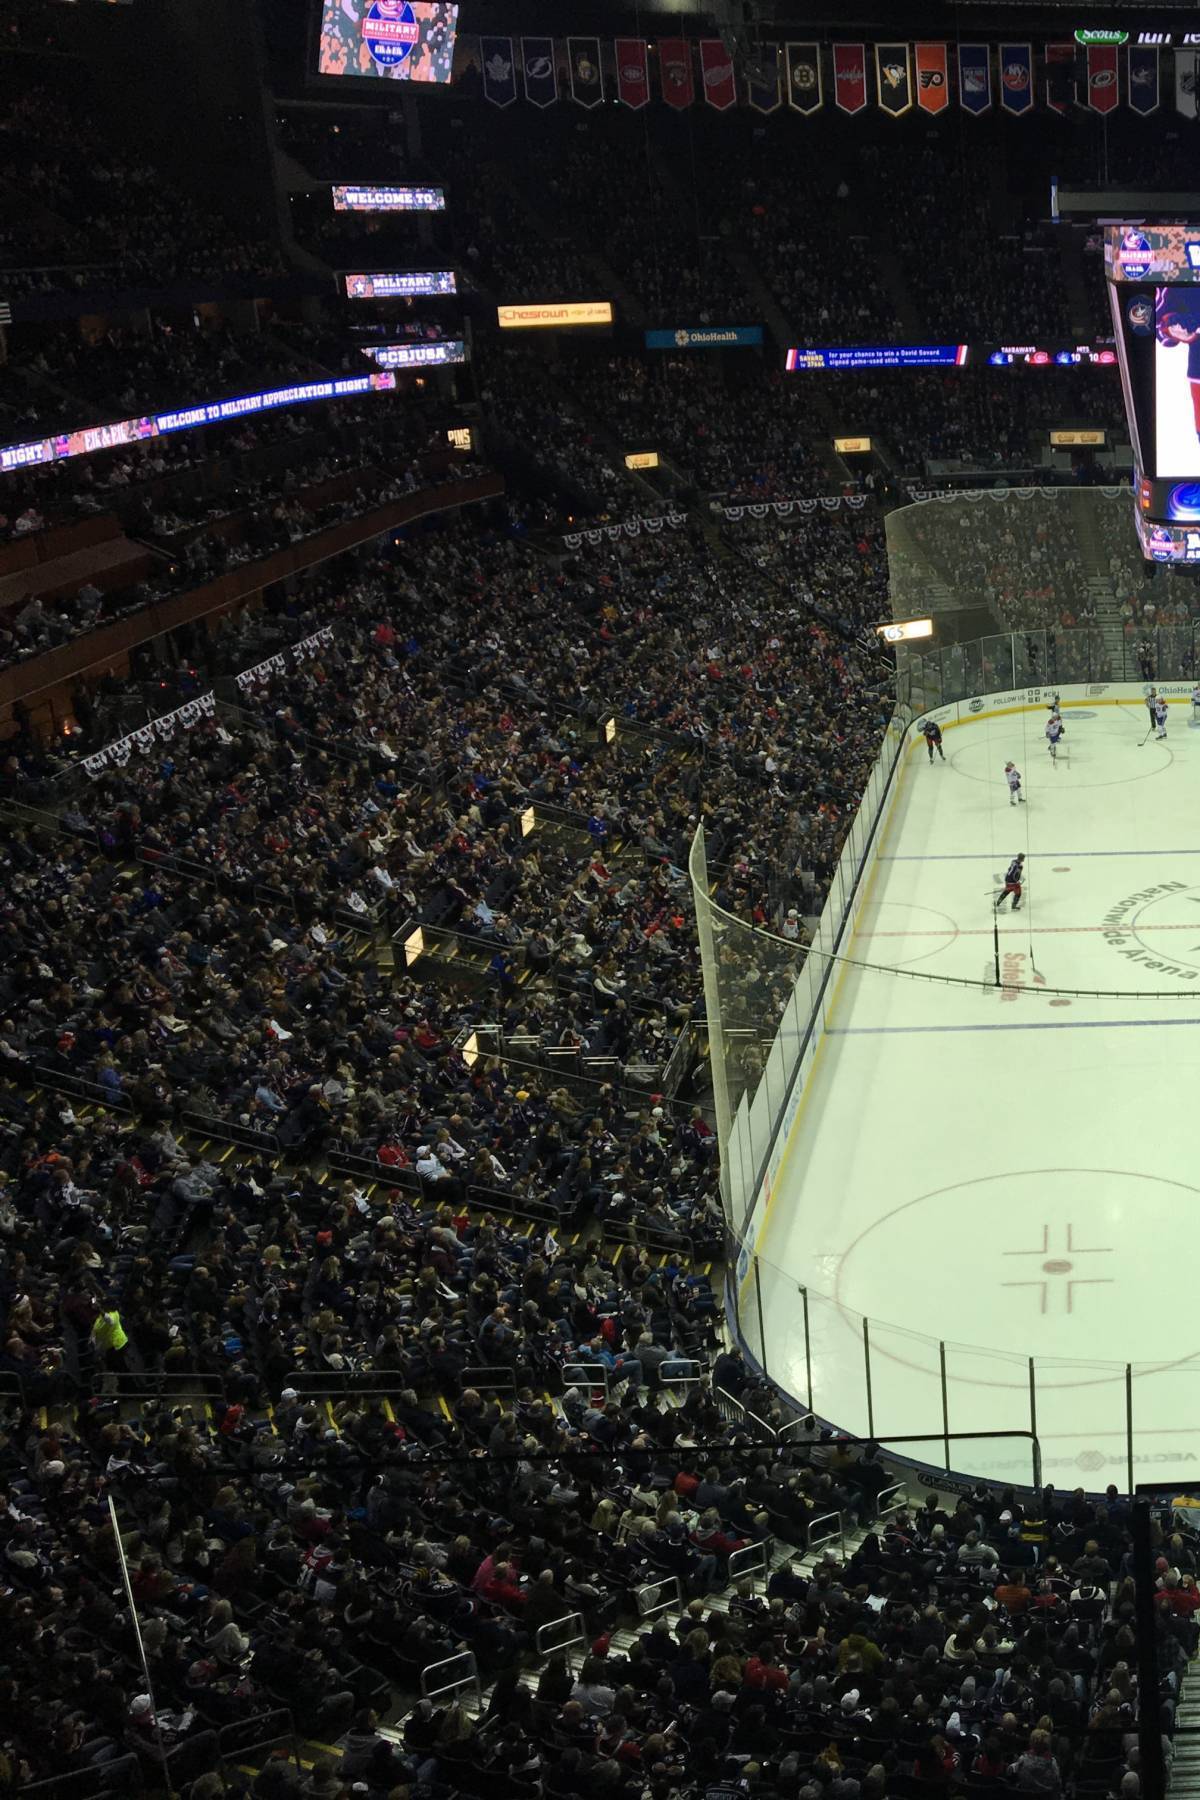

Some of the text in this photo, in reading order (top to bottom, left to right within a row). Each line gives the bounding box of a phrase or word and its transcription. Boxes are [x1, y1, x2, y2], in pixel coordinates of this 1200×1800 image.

[365, 22, 417, 35] MILITARY
[346, 192, 433, 205] WELCOME TO
[373, 277, 432, 288] MILITARY
[502, 309, 568, 320] Chesrown
[690, 331, 738, 343] OhioHealth
[379, 348, 446, 364] #CBJUSA
[1071, 354, 1081, 362] 10
[1089, 354, 1099, 362] 10
[0, 444, 43, 467] NIGHT
[157, 409, 206, 430] WELCOME
[208, 404, 220, 418] TO
[221, 395, 261, 416] MILITARY
[263, 381, 333, 406] APPRECIATION
[335, 377, 369, 393] NIGHT
[448, 429, 470, 445] PINS
[1159, 685, 1195, 694] OhioHea
[1102, 881, 1188, 946] Nationwide
[1117, 949, 1199, 980] Arena
[1108, 1452, 1198, 1465] VECTOR
